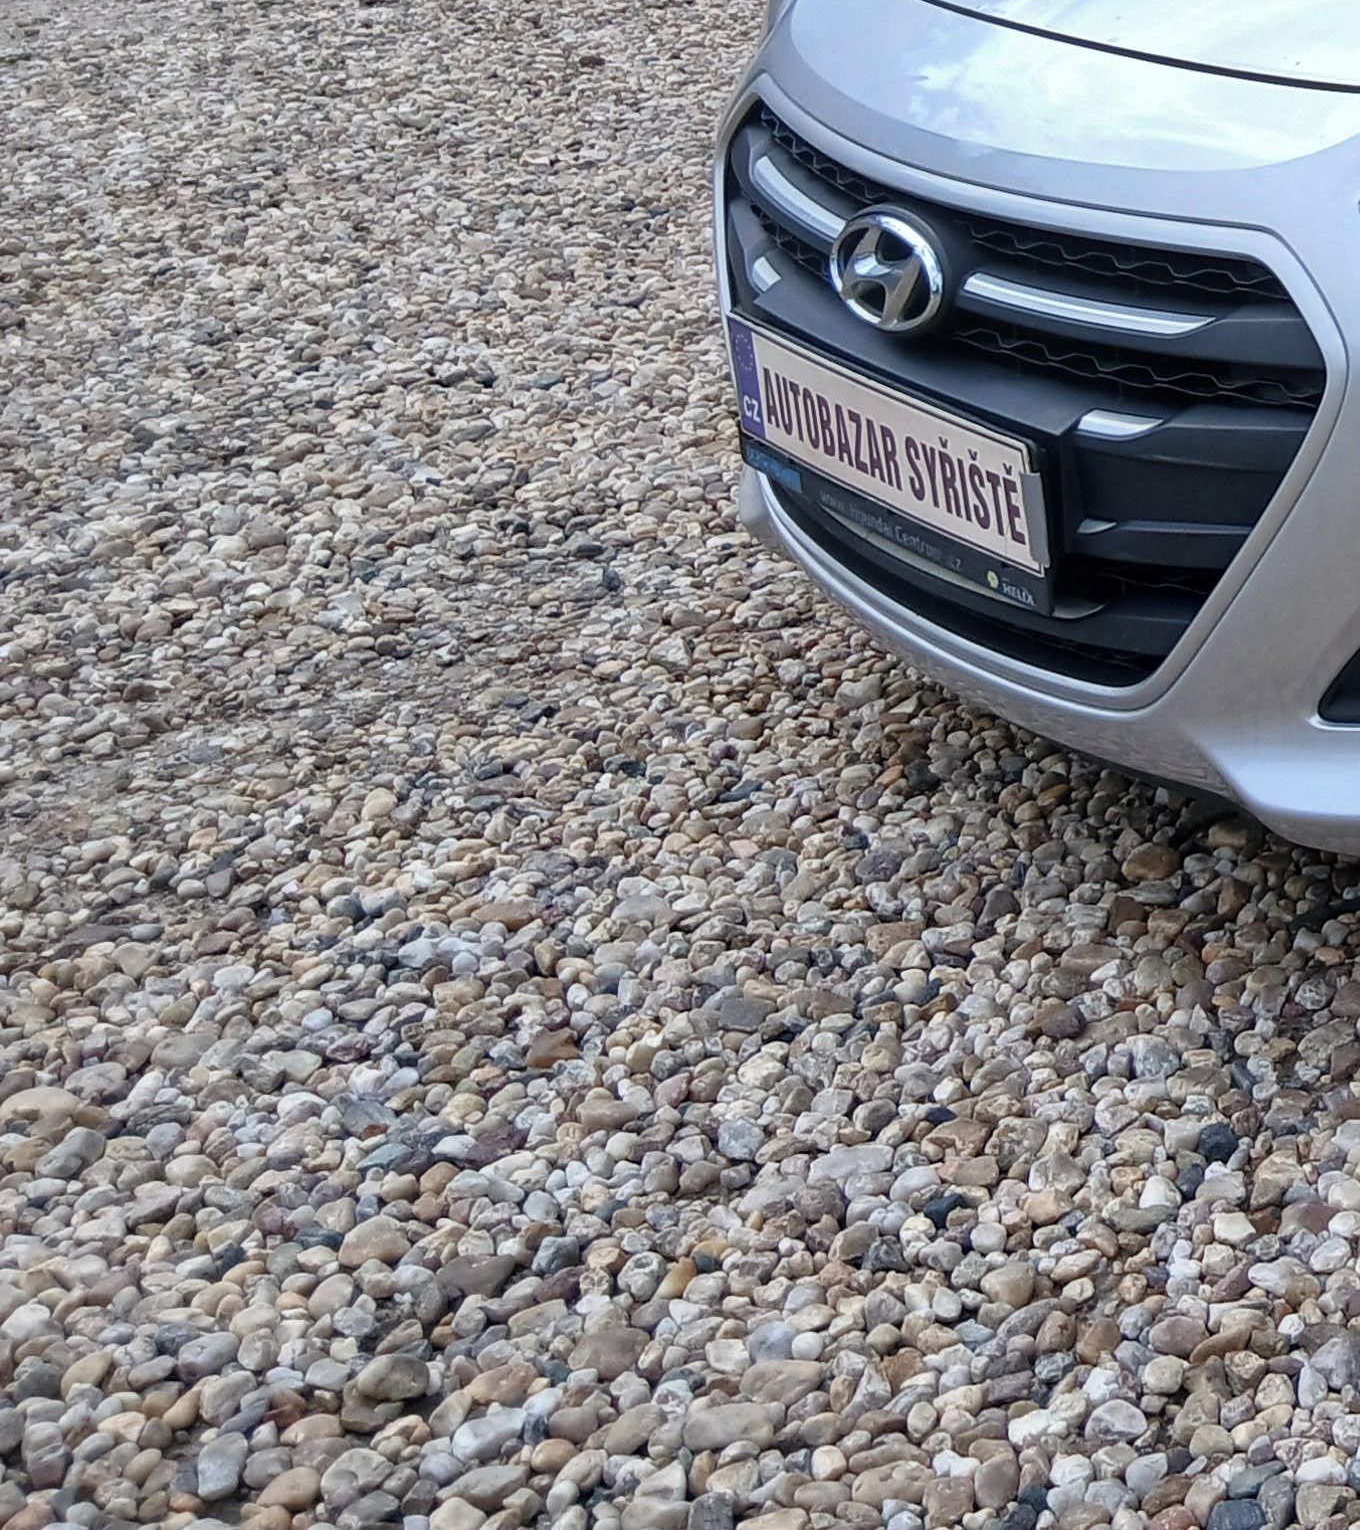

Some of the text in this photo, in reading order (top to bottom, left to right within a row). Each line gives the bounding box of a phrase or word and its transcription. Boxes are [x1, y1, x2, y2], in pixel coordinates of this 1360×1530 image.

[743, 394, 762, 423] CZ
[762, 366, 902, 492] AUTOBAZAR
[904, 437, 1027, 546] SYŘIŠTĚ
[1002, 582, 1036, 607] HELIX
